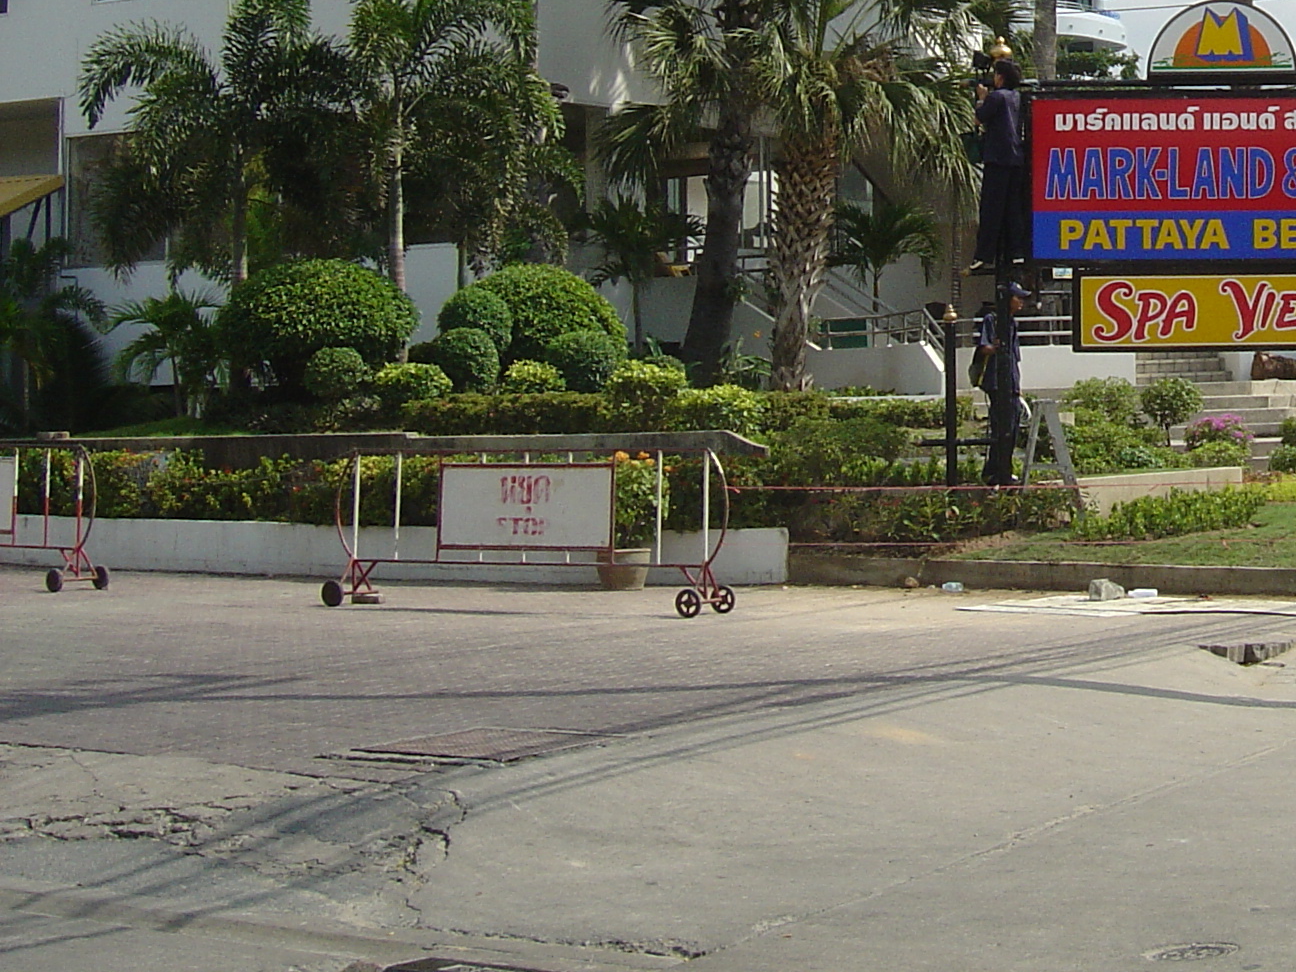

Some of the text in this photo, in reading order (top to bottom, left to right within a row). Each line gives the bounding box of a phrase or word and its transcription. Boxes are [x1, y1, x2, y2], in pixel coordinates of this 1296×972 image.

[1054, 105, 1198, 132] มาร์คแลนด์
[1203, 105, 1280, 131] แอนด์
[1045, 146, 1275, 200] MARK-LAND
[1059, 219, 1230, 250] PATTAYA
